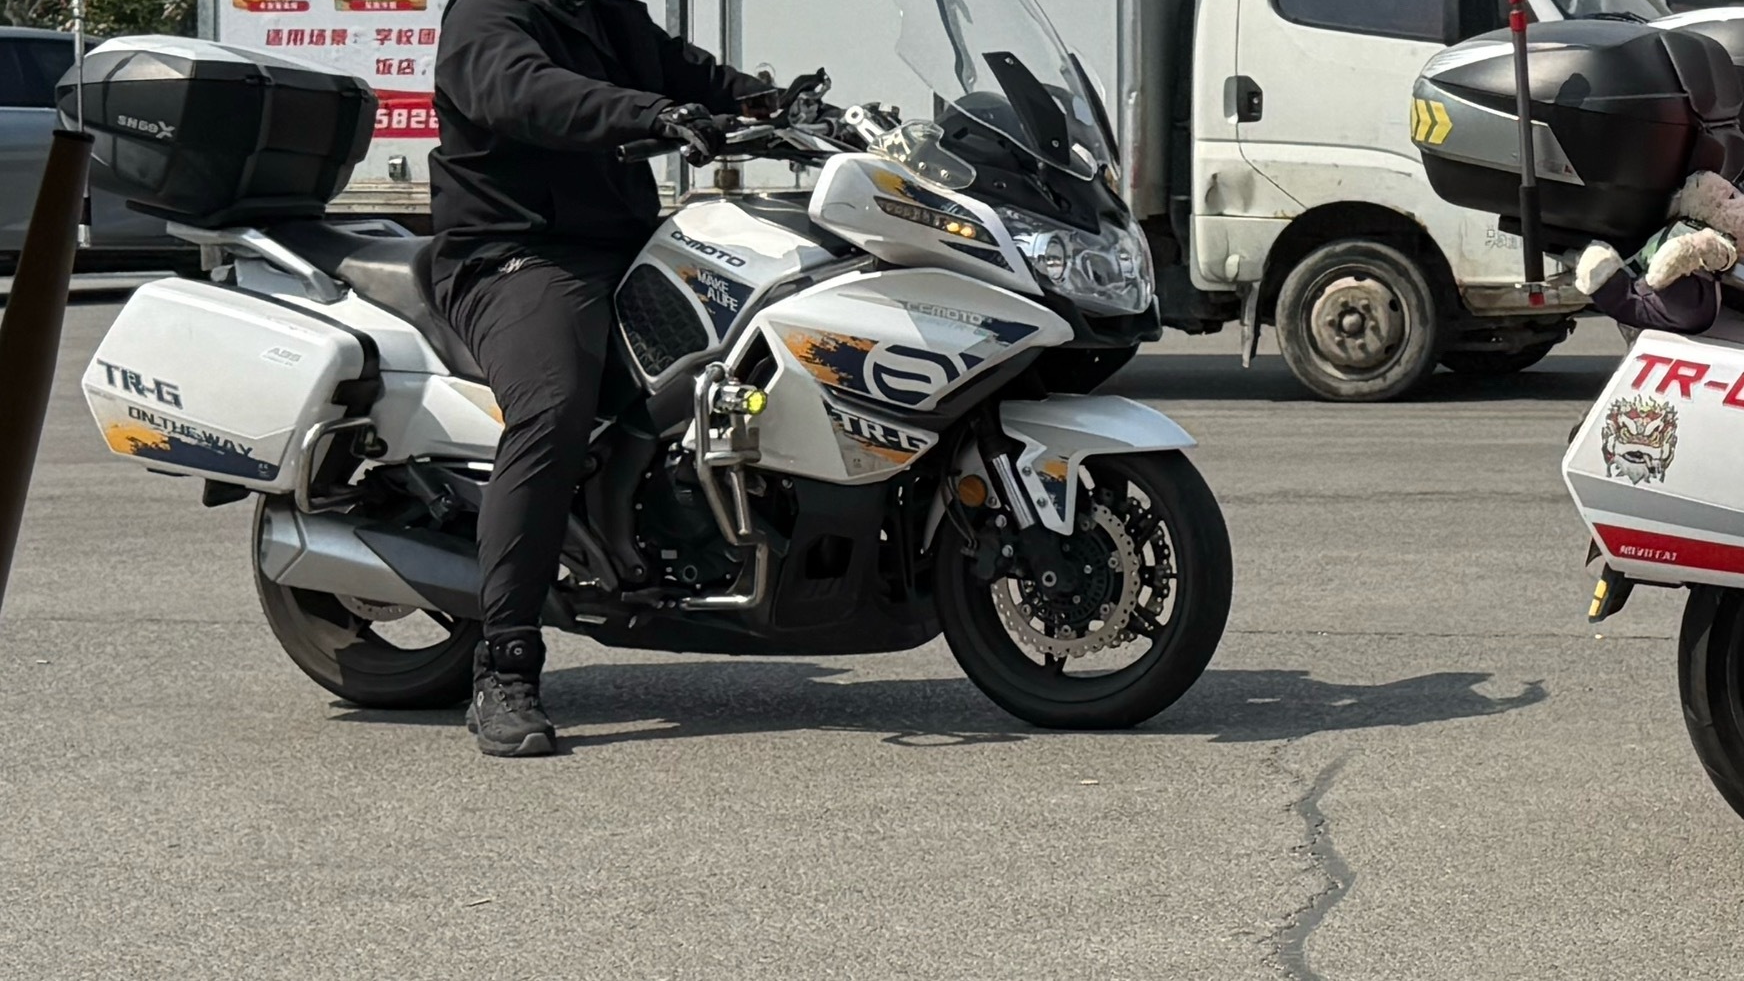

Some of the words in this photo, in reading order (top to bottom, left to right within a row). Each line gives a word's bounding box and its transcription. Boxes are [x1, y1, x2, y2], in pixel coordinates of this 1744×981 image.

[696, 268, 729, 293] MAKE
[97, 357, 184, 410] TR-G
[831, 408, 930, 452] TR-G
